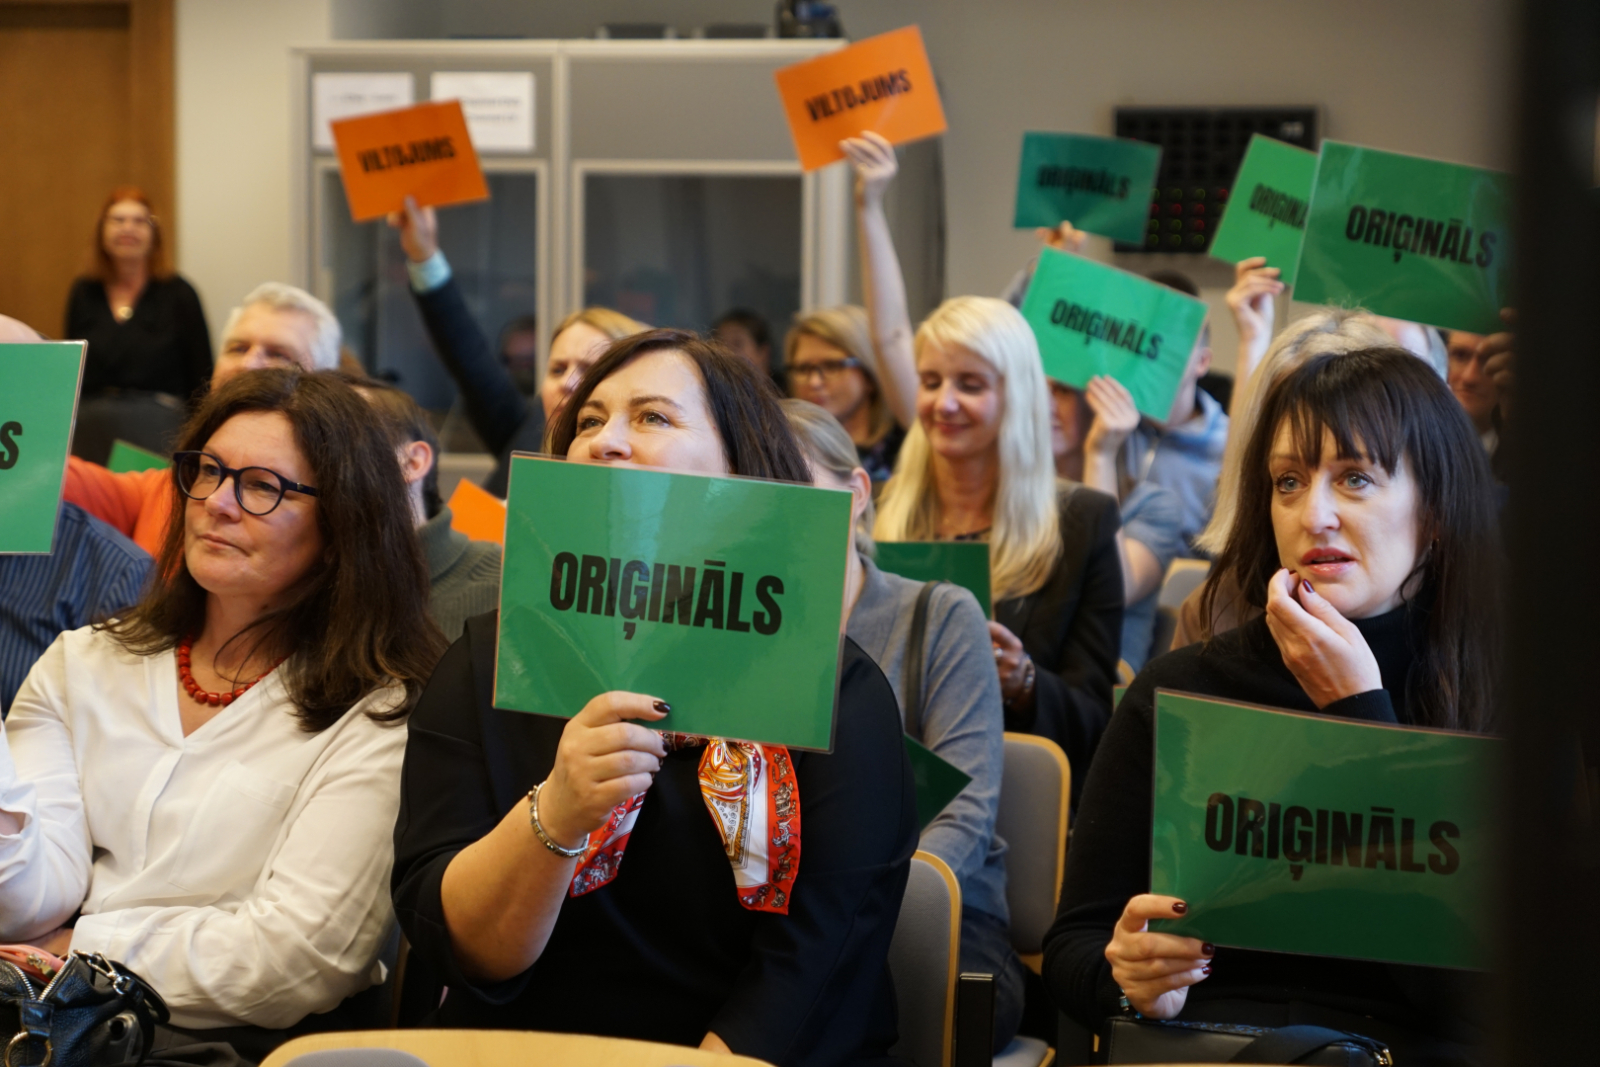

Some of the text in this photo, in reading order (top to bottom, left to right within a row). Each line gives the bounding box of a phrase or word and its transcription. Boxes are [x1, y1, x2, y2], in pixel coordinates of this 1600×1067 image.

[804, 70, 911, 123] VILTOJUMS
[359, 136, 456, 173] VILTOJUMS
[1345, 203, 1498, 268] ORIĢINĀLS
[1050, 298, 1164, 361] ORIĢINĀLS
[550, 551, 784, 640] ORIĢINĀLS
[1204, 793, 1461, 881] ORIĢINĀLS
